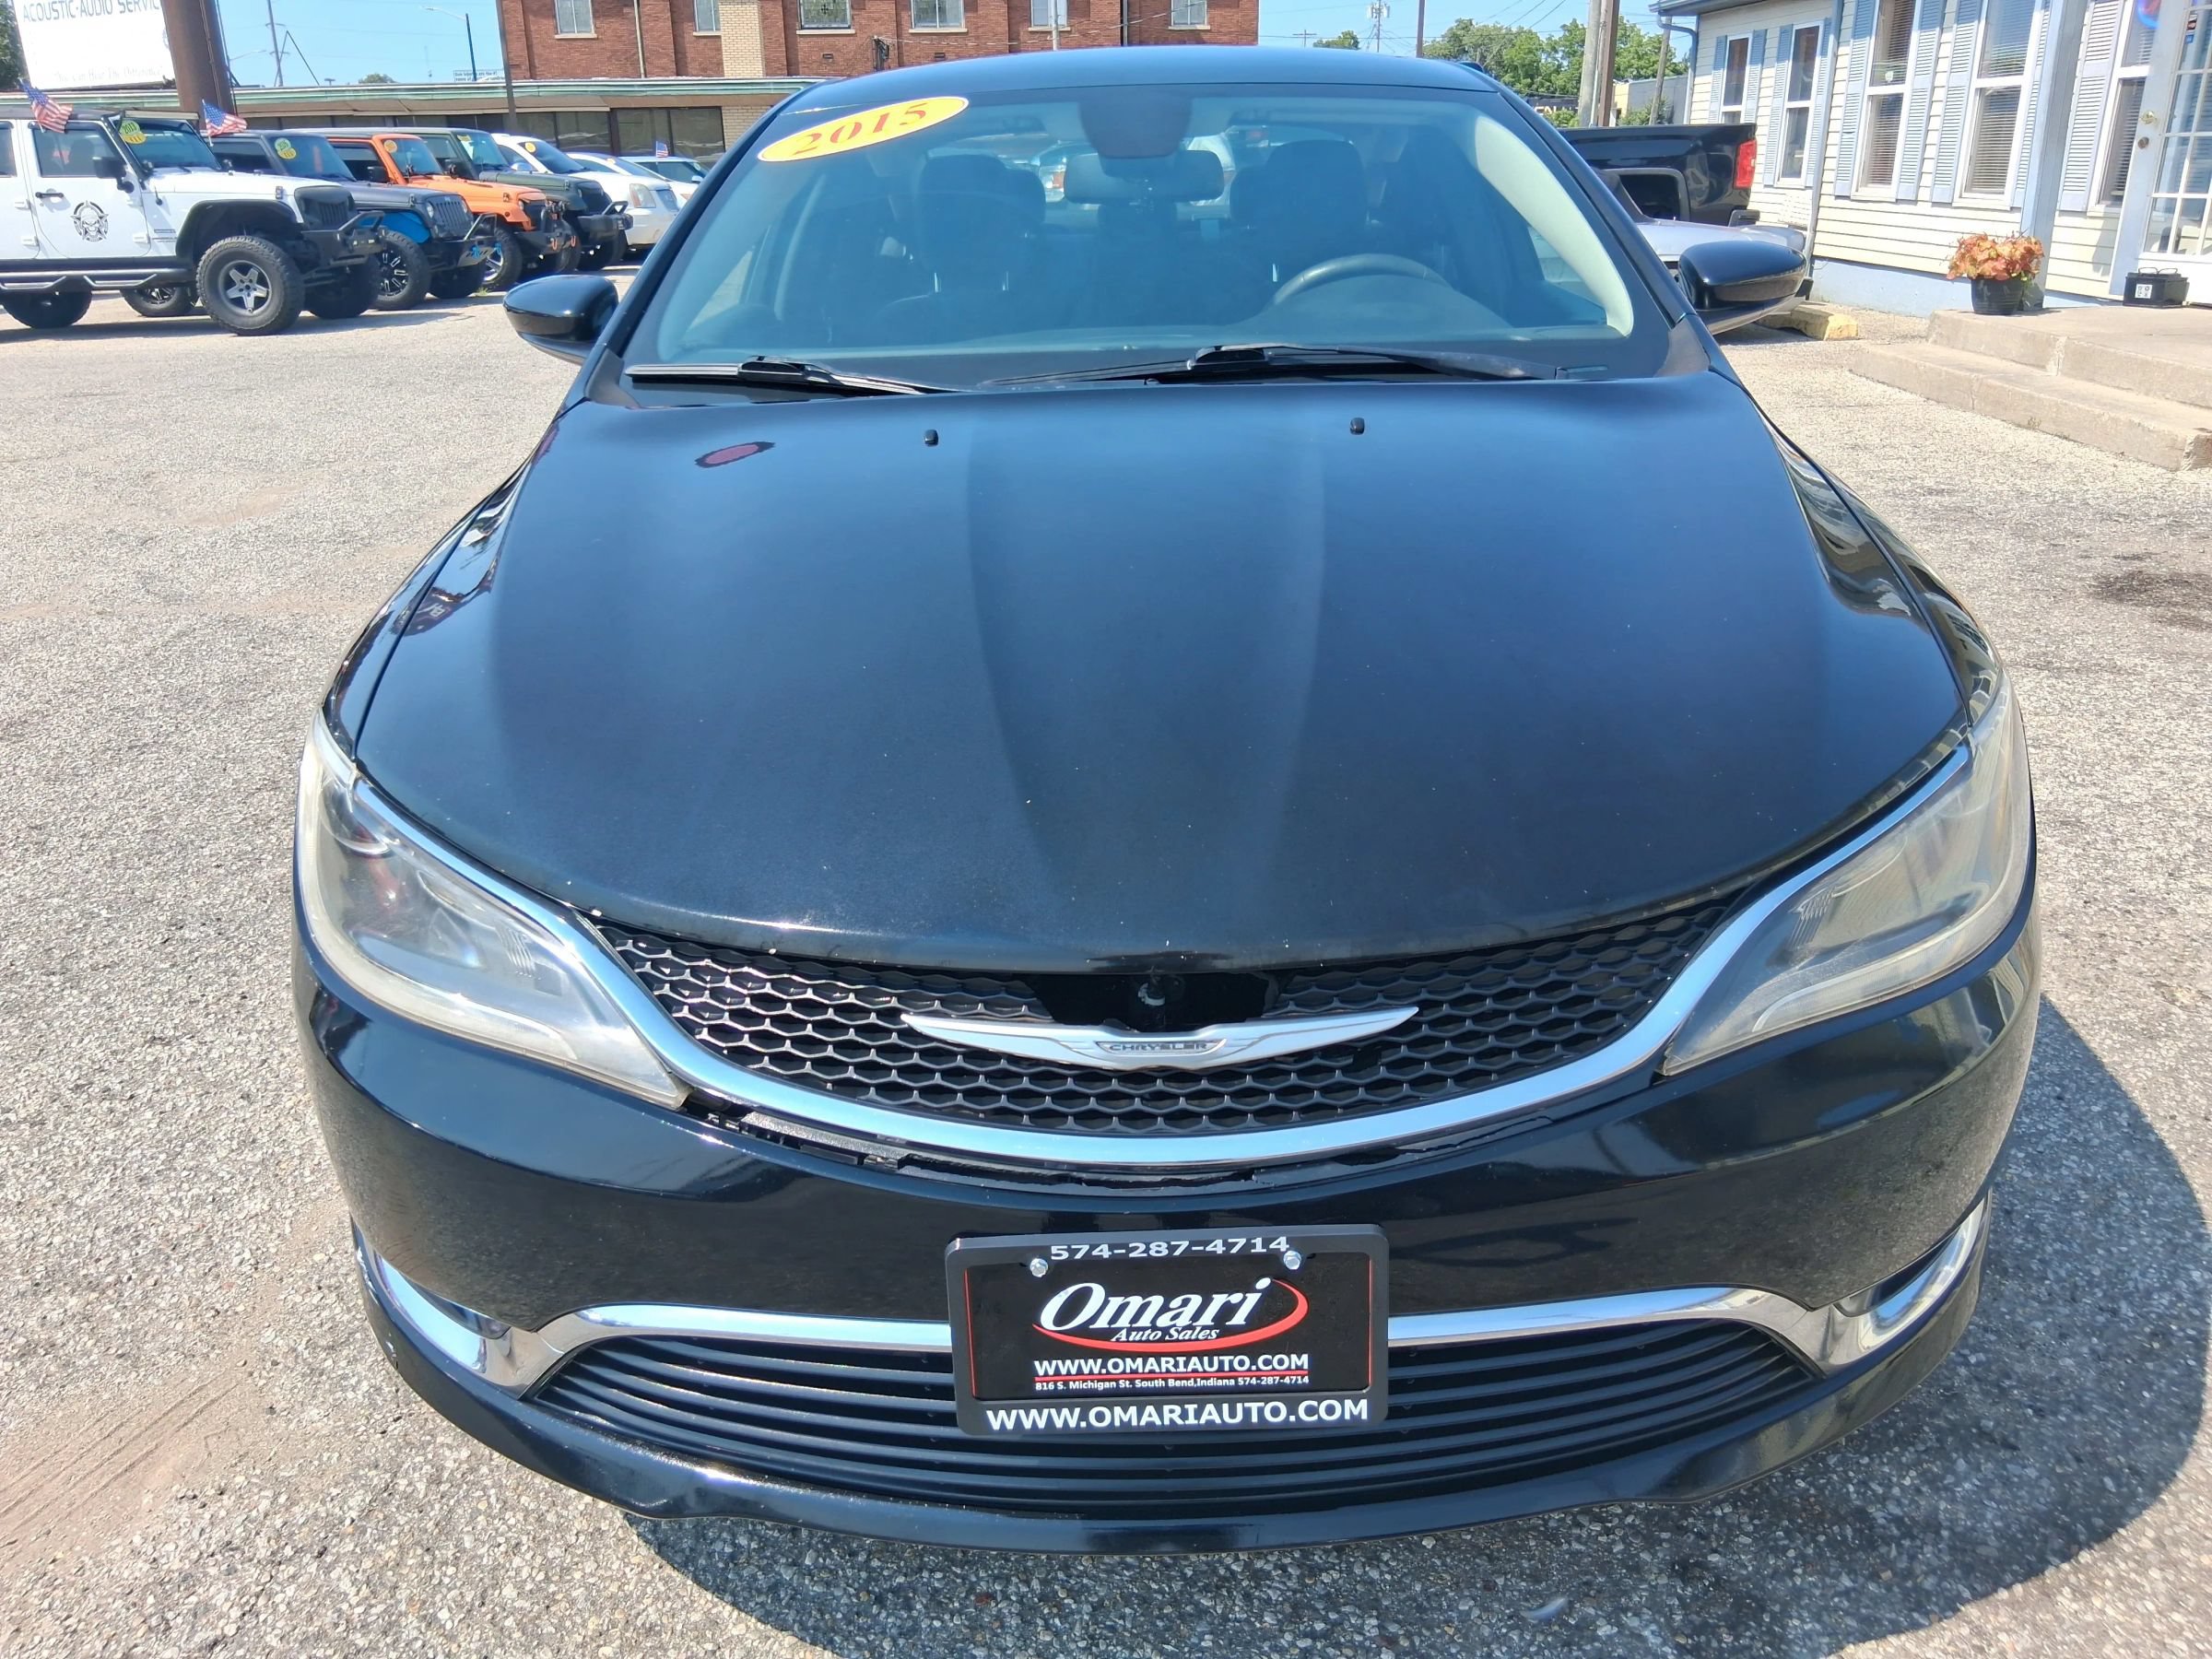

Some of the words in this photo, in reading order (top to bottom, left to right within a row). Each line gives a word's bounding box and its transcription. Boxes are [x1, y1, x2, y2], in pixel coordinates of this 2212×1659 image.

[793, 102, 927, 156] 2015
[1109, 1042, 1207, 1052] CHRYSLER
[1050, 1236, 1289, 1260] 574-287-4714
[1041, 1277, 1271, 1331] Omari
[1111, 1328, 1160, 1342] Auto
[1164, 1325, 1219, 1341] Sales
[1033, 1354, 1309, 1376] WWW.OMARIAUTO.COM
[1035, 1382, 1054, 1391] 816
[1057, 1382, 1066, 1390] S.
[1069, 1380, 1116, 1390] Michigan
[1119, 1380, 1133, 1388] St.
[1135, 1378, 1166, 1387] South
[1169, 1377, 1235, 1387] Bend,Indiana
[1238, 1375, 1309, 1385] 574-287-4714
[986, 1398, 1369, 1431] WWW.OMARIAUTO.COM
